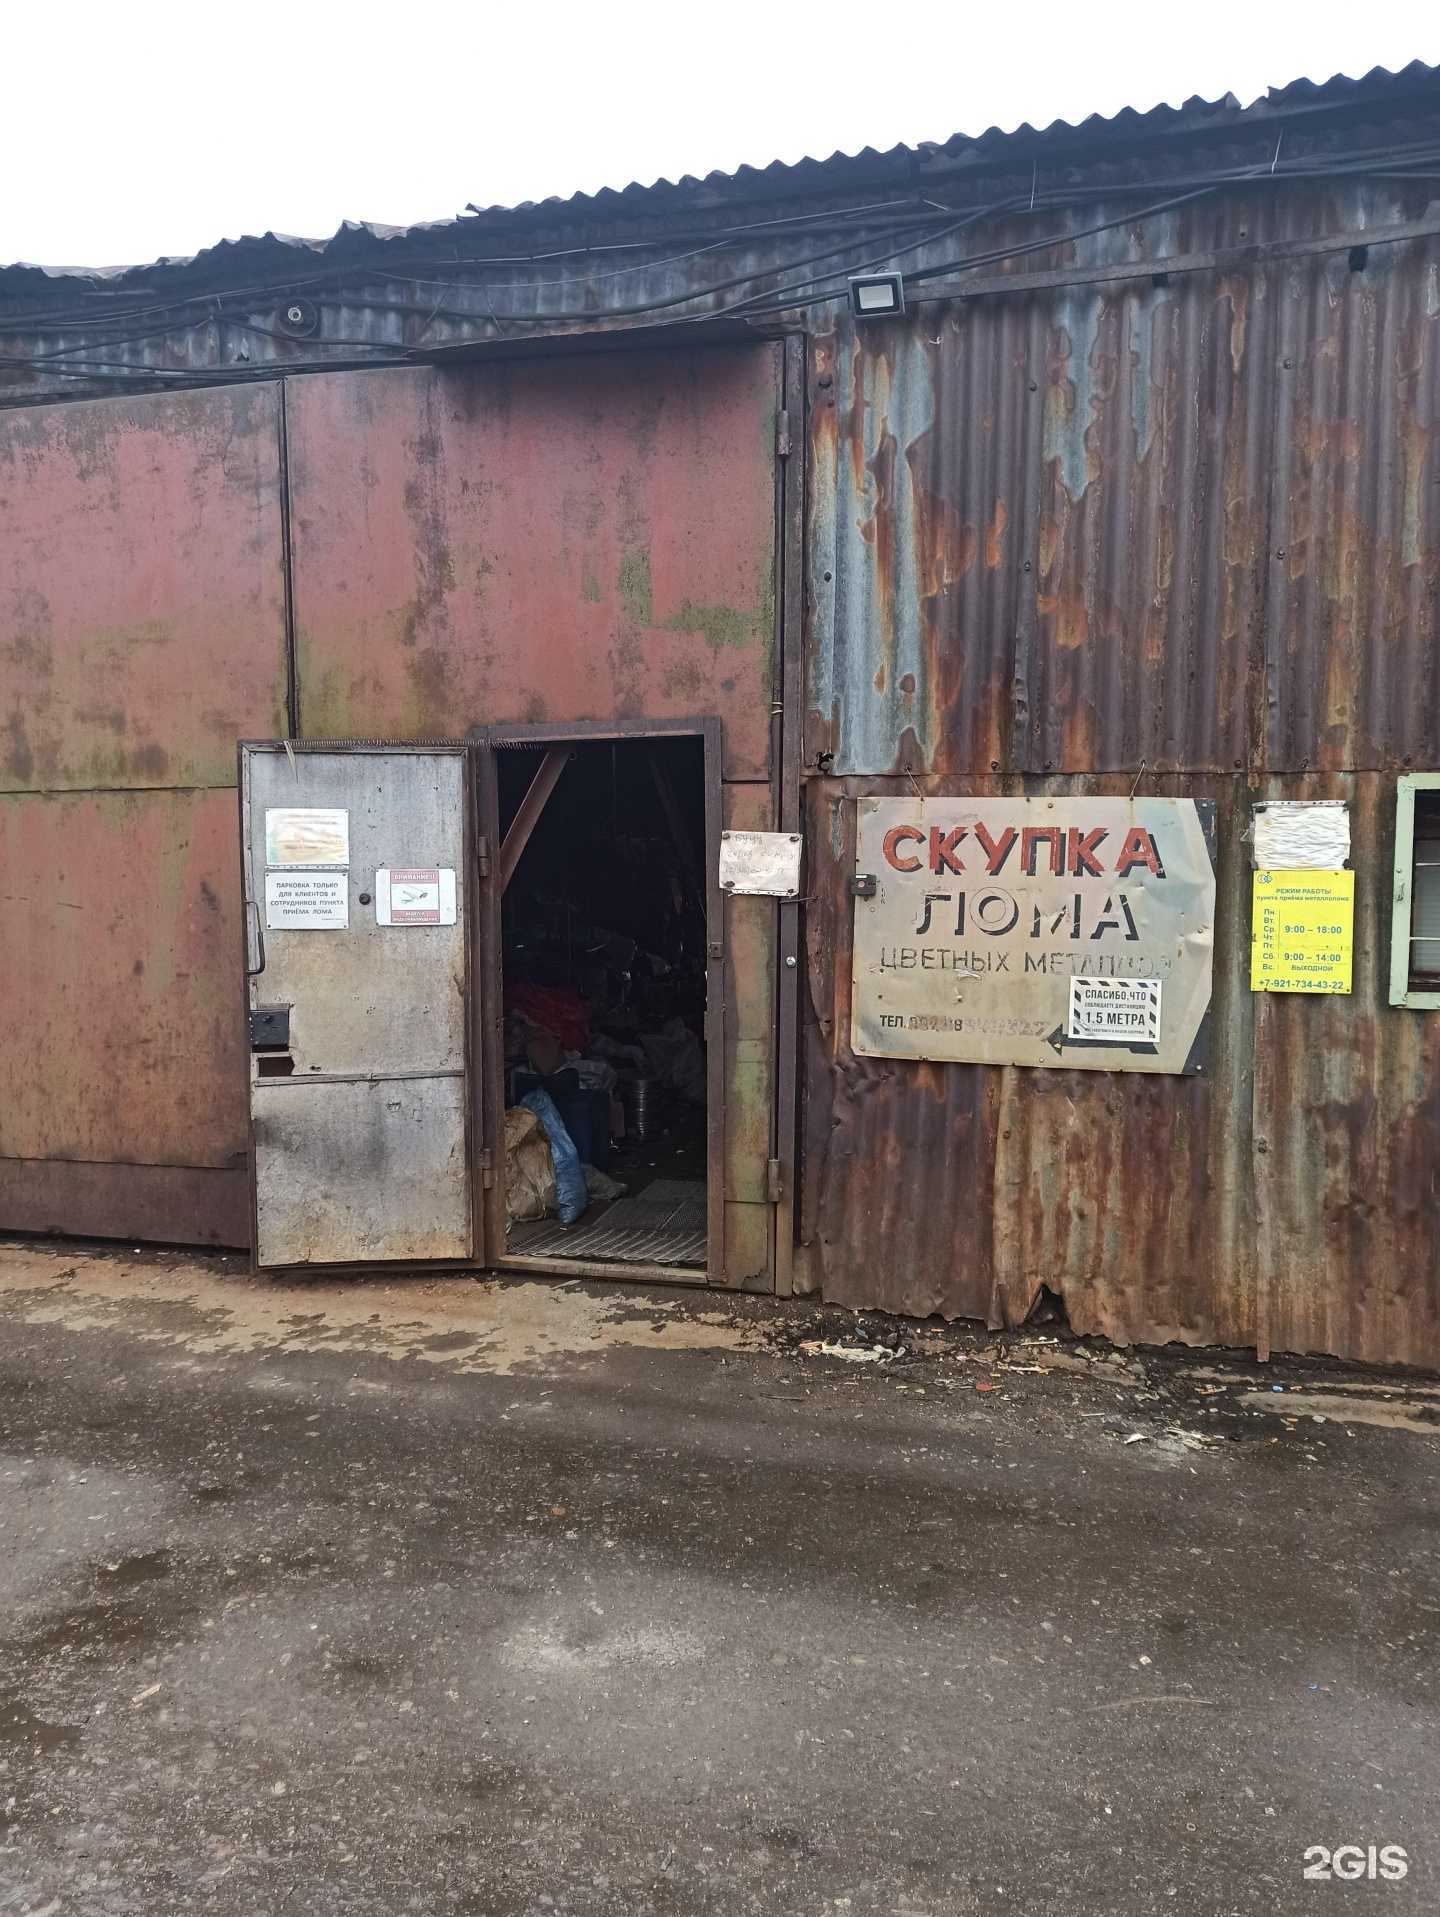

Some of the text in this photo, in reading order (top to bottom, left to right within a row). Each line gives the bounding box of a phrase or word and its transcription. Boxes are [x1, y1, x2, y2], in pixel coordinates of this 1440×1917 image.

[883, 821, 1166, 878] СКУПКА
[915, 885, 1139, 940] ЛОМА
[1284, 925, 1305, 934] 9:00
[1316, 926, 1342, 935] 18:00
[880, 947, 1010, 972] ЦВЕТНЫХ
[1284, 952, 1305, 961] 9:00
[1316, 953, 1341, 962] 14:00
[1259, 979, 1344, 990] +7-921-734-43-22
[1086, 1011, 1145, 1026] 1.5 МЕТРА
